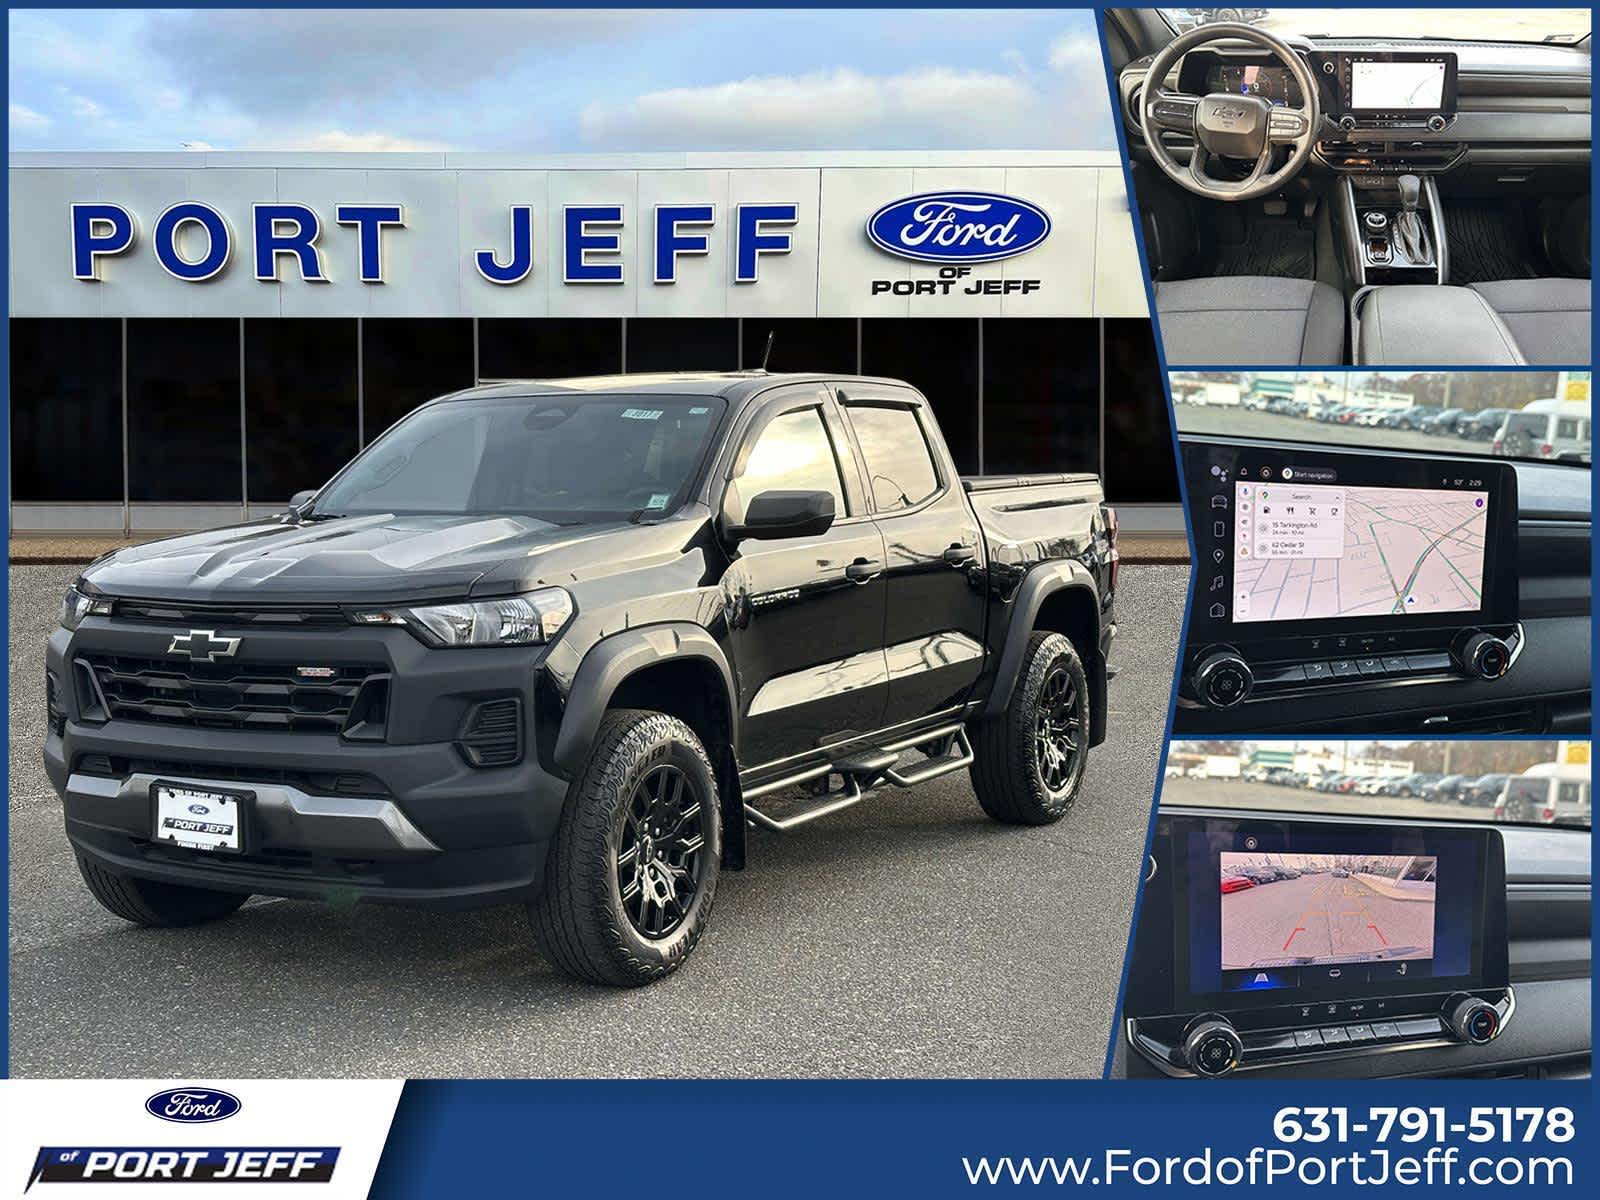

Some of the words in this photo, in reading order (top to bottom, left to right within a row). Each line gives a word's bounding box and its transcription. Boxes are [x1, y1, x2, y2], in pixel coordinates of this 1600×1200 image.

[900, 201, 1021, 246] Ford
[70, 202, 403, 282] PORT
[474, 202, 800, 285] JEFF
[939, 267, 971, 279] OF
[871, 280, 956, 295] PORT
[964, 280, 1041, 295] JEFF
[174, 820, 202, 831] PORT
[204, 824, 229, 833] JEFF
